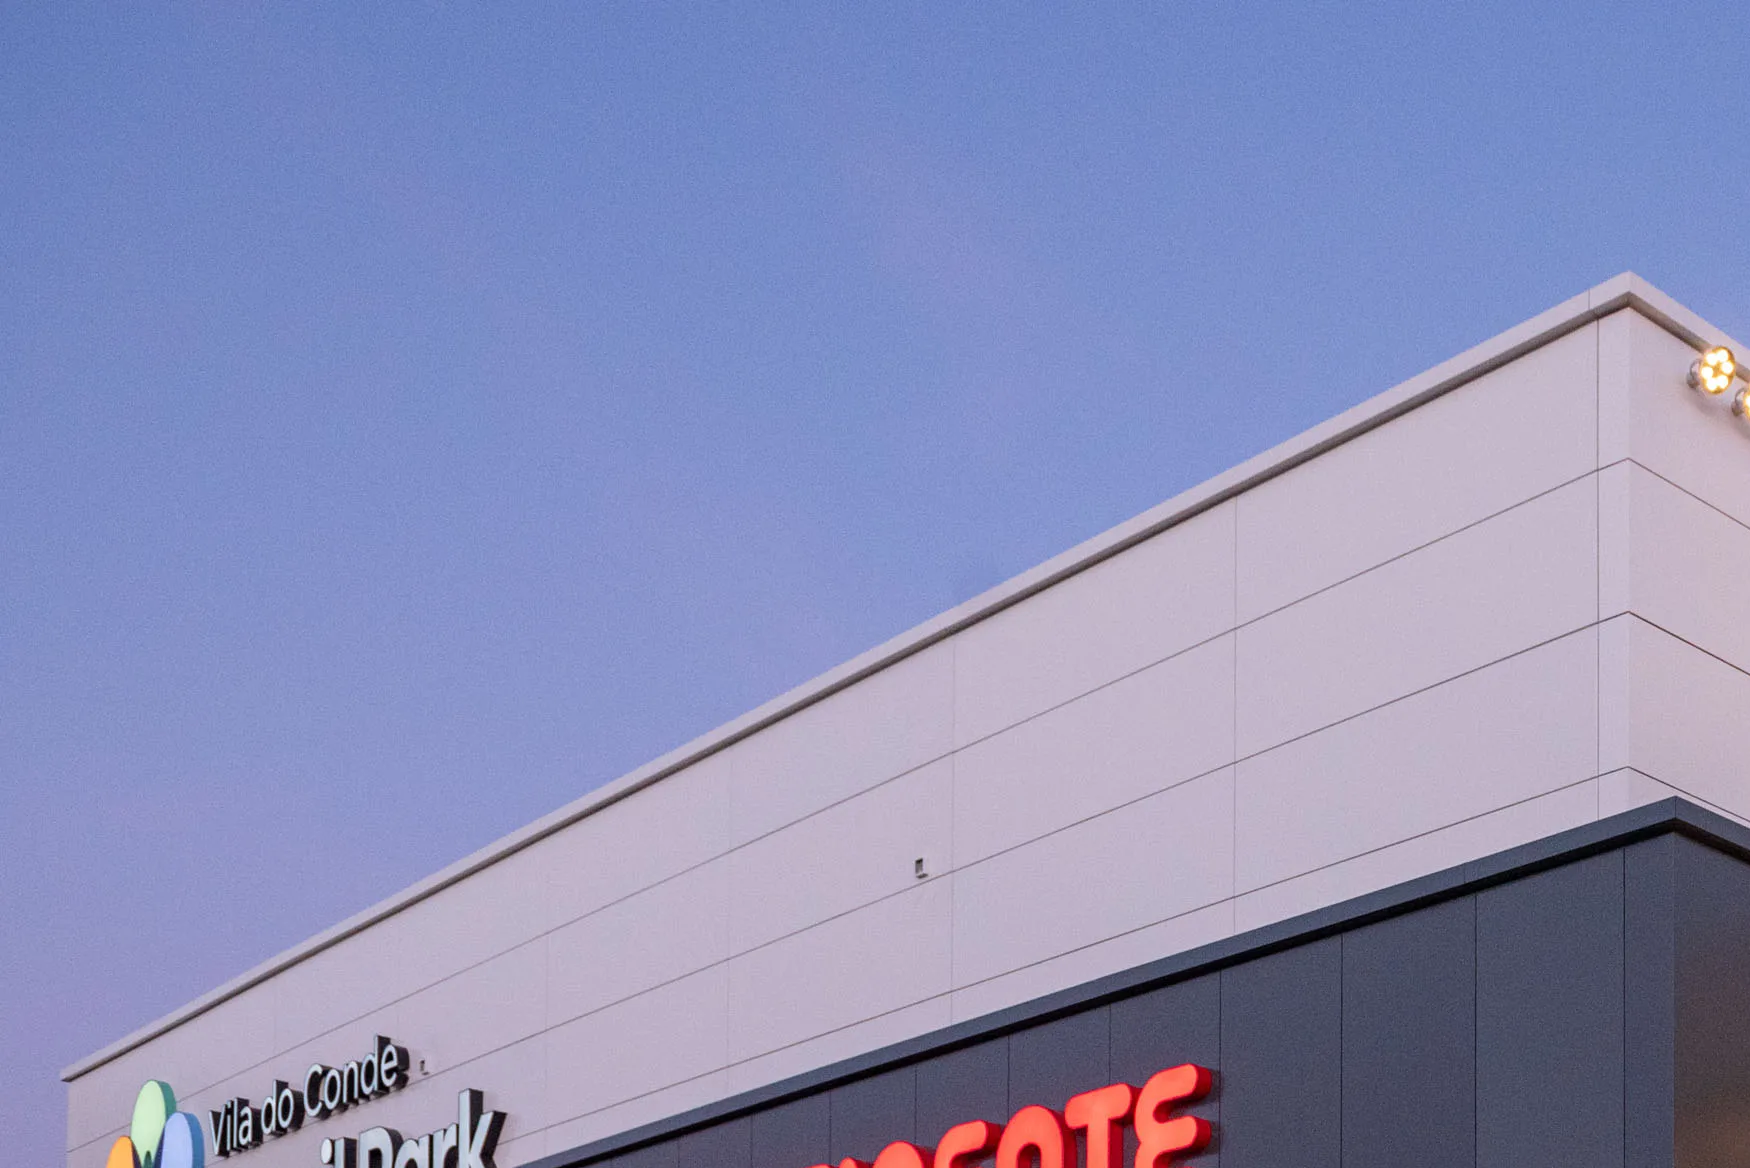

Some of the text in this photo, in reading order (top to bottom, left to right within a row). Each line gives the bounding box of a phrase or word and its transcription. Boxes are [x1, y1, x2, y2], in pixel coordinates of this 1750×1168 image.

[209, 1035, 409, 1156] Vila do Conde
